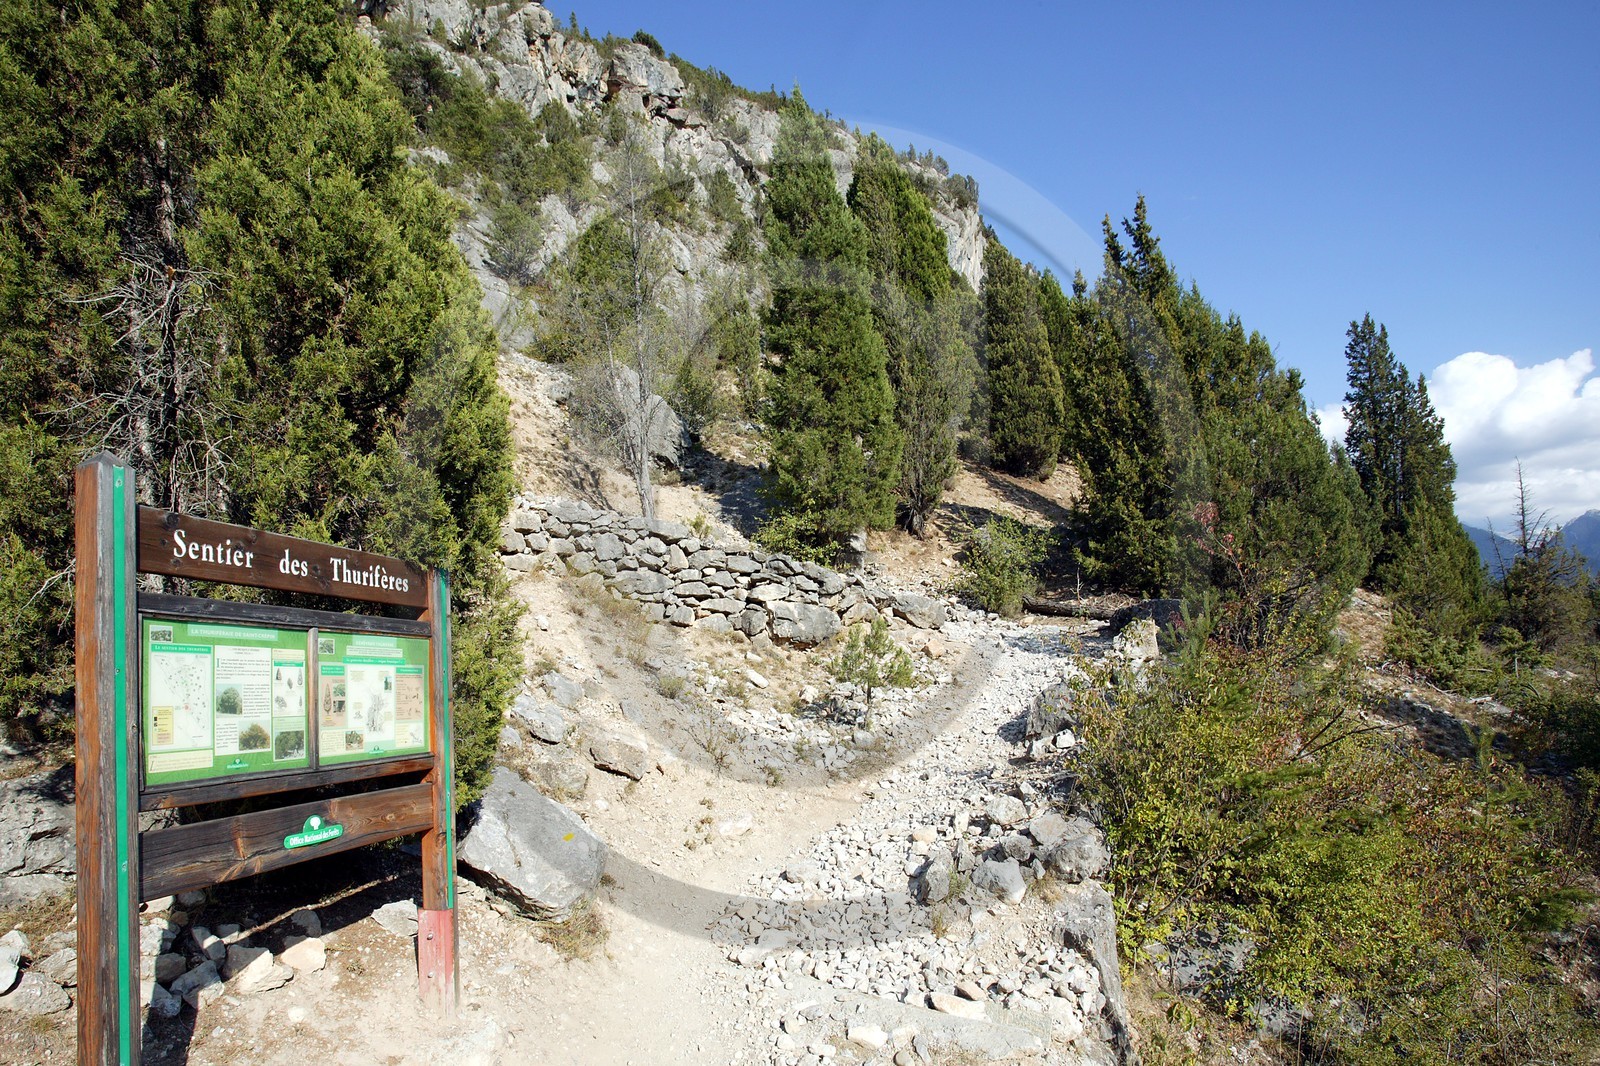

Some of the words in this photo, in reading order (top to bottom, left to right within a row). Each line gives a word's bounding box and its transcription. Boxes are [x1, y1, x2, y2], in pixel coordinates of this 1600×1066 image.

[173, 529, 254, 569] Sentier
[279, 549, 308, 577] des
[330, 556, 409, 593] Thurifères
[290, 837, 304, 847] Office
[304, 831, 323, 843] National
